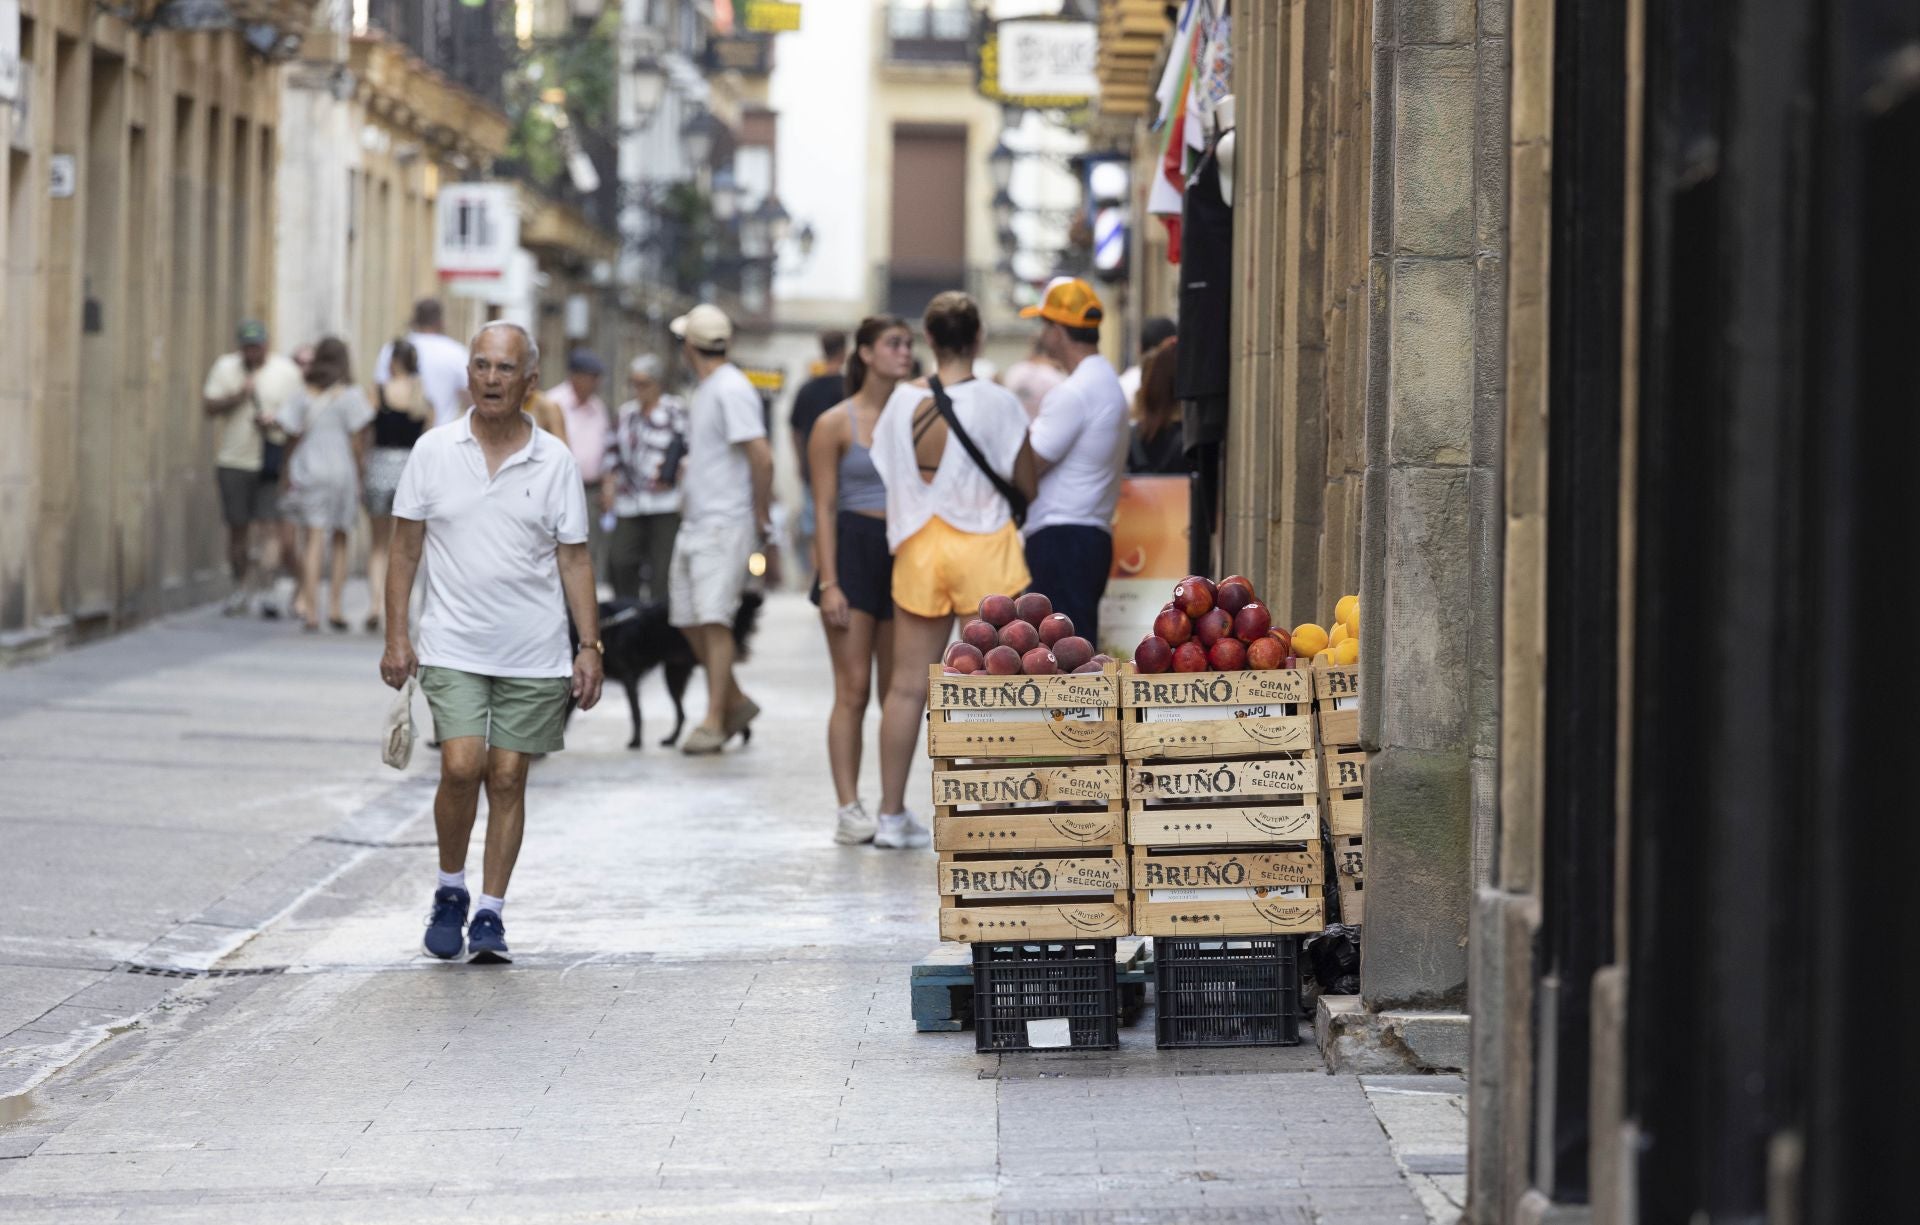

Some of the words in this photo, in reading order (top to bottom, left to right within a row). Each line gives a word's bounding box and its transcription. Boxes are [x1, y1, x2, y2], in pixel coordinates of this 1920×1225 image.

[940, 678, 1041, 707] BRUÑÓ
[1069, 685, 1100, 697] GRAN
[1132, 674, 1232, 704] BRUÑÓ
[1260, 680, 1291, 692] GRAN
[1057, 693, 1109, 707] SELECCIÓN
[1248, 688, 1301, 702] SELECCIÓN
[1263, 770, 1294, 782] GRAN
[942, 772, 1042, 802] BRUÑÓ
[1070, 778, 1101, 790] GRAN
[1251, 778, 1303, 791] SELECCIÓN
[1058, 786, 1110, 800] SELECCIÓN
[1078, 868, 1110, 880] GRAN
[1144, 856, 1245, 887] BRUÑÓ
[1272, 863, 1304, 875] GRAN
[950, 861, 1051, 892] BRUÑÓ
[1066, 876, 1119, 889] SELECCIÓN
[1261, 871, 1313, 884] SELECCIÓN
